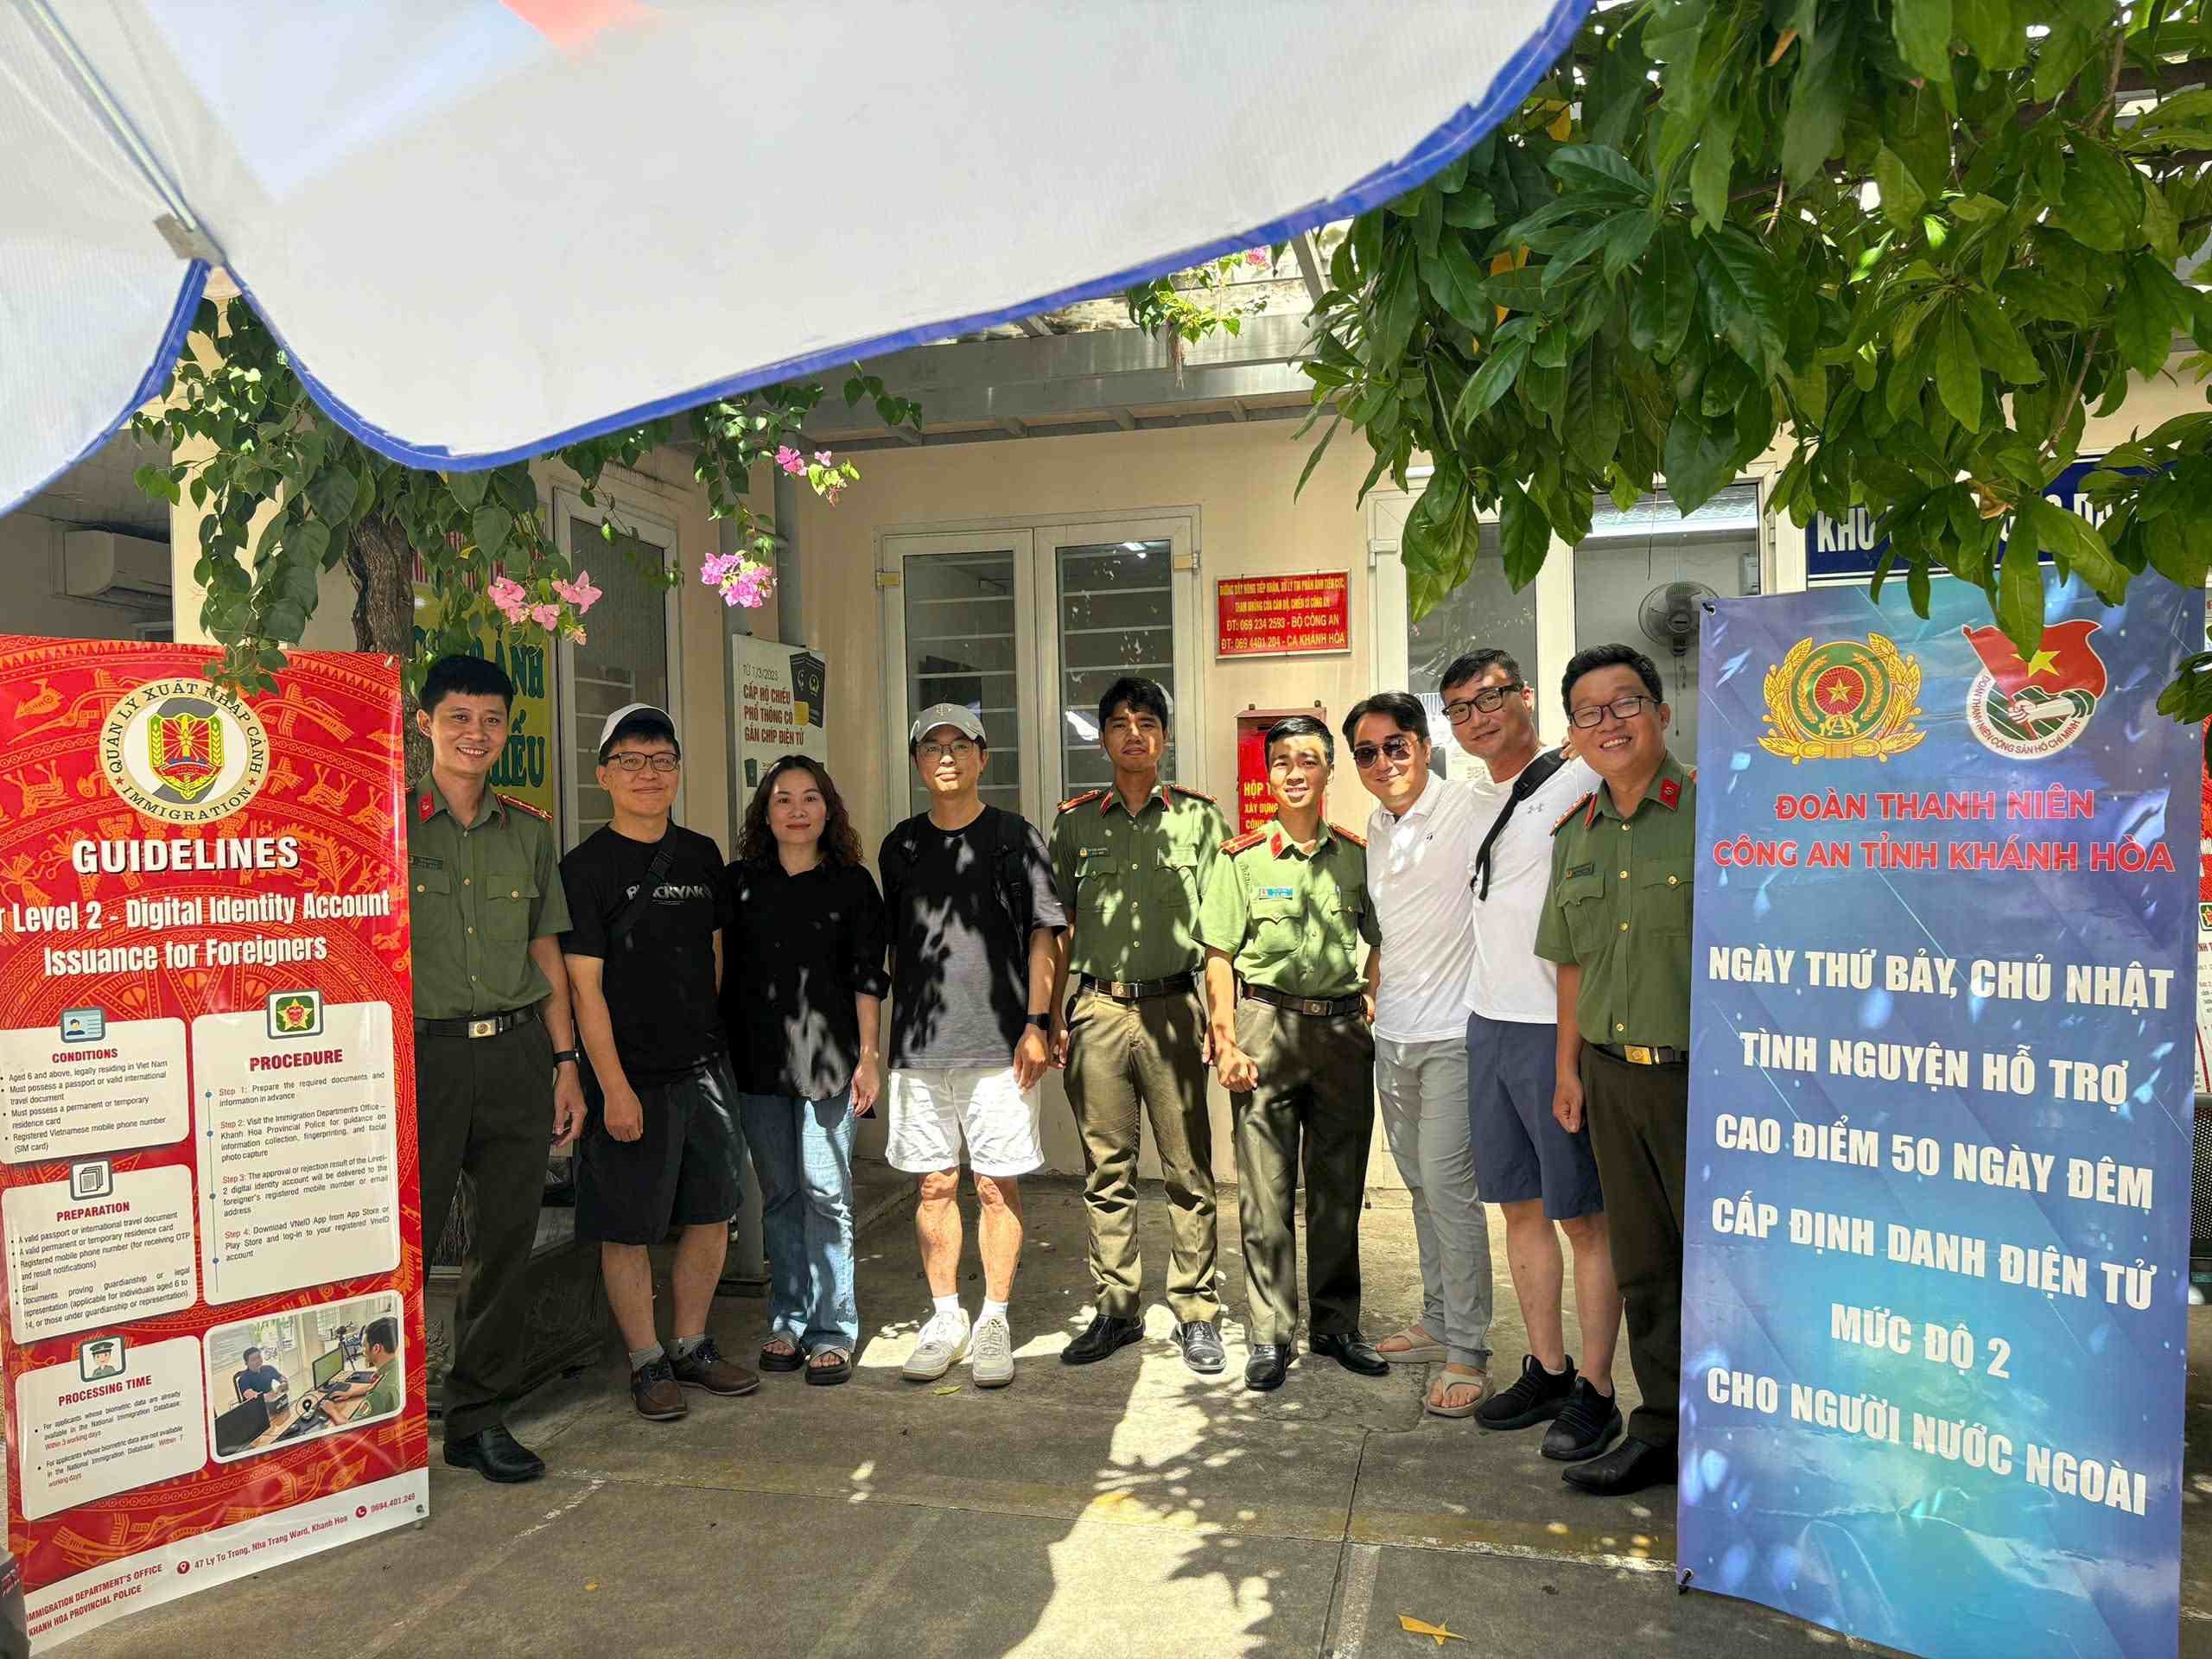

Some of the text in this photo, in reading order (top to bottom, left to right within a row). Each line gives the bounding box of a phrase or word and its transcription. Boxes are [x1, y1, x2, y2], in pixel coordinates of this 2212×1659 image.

[1817, 505, 1875, 553] KHU
[1287, 635, 1298, 646] CA
[1300, 632, 1326, 645] KHÁNH
[1329, 629, 1344, 644] HÒA
[1291, 614, 1303, 628] BỘ
[1305, 613, 1326, 627] CÔNG
[1328, 614, 1338, 626] AN
[743, 681, 758, 699] CẤP
[771, 685, 791, 705] CHIẾU
[103, 721, 123, 773] QUẢN
[143, 679, 198, 702] XUẤT
[246, 726, 267, 774] CẢNH
[760, 706, 783, 723] THÔNG
[1972, 698, 1983, 727] THANH
[1991, 737, 2013, 753] CÔNG
[2015, 744, 2032, 754] SẢN
[2035, 741, 2048, 753] HỒ
[2048, 735, 2063, 748] CHÍ
[2062, 721, 2081, 740] MINH
[779, 728, 794, 747] ĐIỆN
[123, 786, 252, 821] IMMIGRATION
[1244, 779, 1263, 798] HỘP
[1775, 783, 2095, 821] ĐOÀN THANH NIÊN
[1244, 800, 1258, 813] XÂY
[72, 836, 299, 874] GUIDELINES
[1713, 834, 1798, 868] CÔNG
[1806, 841, 1852, 868] AN
[1860, 832, 1937, 869] TỈNH
[1948, 835, 2077, 871] KHÁNH
[2089, 836, 2176, 873] HÒA
[13, 901, 79, 932] Level
[86, 901, 101, 930] 2
[126, 896, 203, 930] Digital
[209, 892, 296, 924] Identity
[303, 890, 390, 918] Account
[43, 935, 327, 976] Issuance for Foreigners
[1709, 943, 1796, 984] NGÀY
[1805, 948, 1877, 990] THỨ
[1885, 948, 1957, 999] BẢY,
[1970, 954, 2051, 1001] CHỦ
[2065, 961, 2175, 1015] NHẬT
[34, 1071, 48, 1079] and
[74, 1067, 96, 1077] legally
[99, 1064, 126, 1075] residing
[136, 1061, 149, 1071] Viet
[52, 1048, 118, 1064] CONDITIONS
[250, 1049, 343, 1071] PROCEDURE
[1738, 1027, 2130, 1112] TÌNH NGUYỆN HỖ TRỢ
[10, 1084, 26, 1094] Must
[28, 1083, 56, 1093] possess
[65, 1079, 95, 1090] passport
[106, 1076, 123, 1084] valid
[124, 1071, 167, 1082] international
[10, 1094, 65, 1106] travel document
[11, 1108, 28, 1117] Must
[29, 1106, 58, 1117] possess
[67, 1101, 103, 1113] permanent
[114, 1096, 149, 1109] temporary
[12, 1117, 60, 1129] residence card
[13, 1116, 167, 1141] Registered Vietnamese mobile phone number
[1715, 1113, 2154, 1209] CAO ĐIỂM 50 NGÀY ĐÊM
[56, 1201, 130, 1222] PREPARATION
[1712, 1191, 2157, 1310] CẤP ĐỊNH DANH ĐIỆN TỬ
[1831, 1301, 2011, 1379] MỨC ĐỘ 2
[58, 1375, 152, 1406] PROCESSING TIME
[1707, 1366, 2147, 1516] CHO NGƯỜI NƯỚC NGOÀI
[194, 1559, 205, 1569] 47
[205, 1557, 215, 1567] Ly
[251, 1541, 266, 1552] Nha
[267, 1533, 289, 1548] Trang
[312, 1520, 333, 1532] Khanh
[334, 1515, 348, 1525] Hoa
[27, 1563, 163, 1622] IMMIGRATION DEPARTMENT'S OFFICE
[28, 1584, 143, 1637] KHANH HOA PROVINCIAL POLICE
